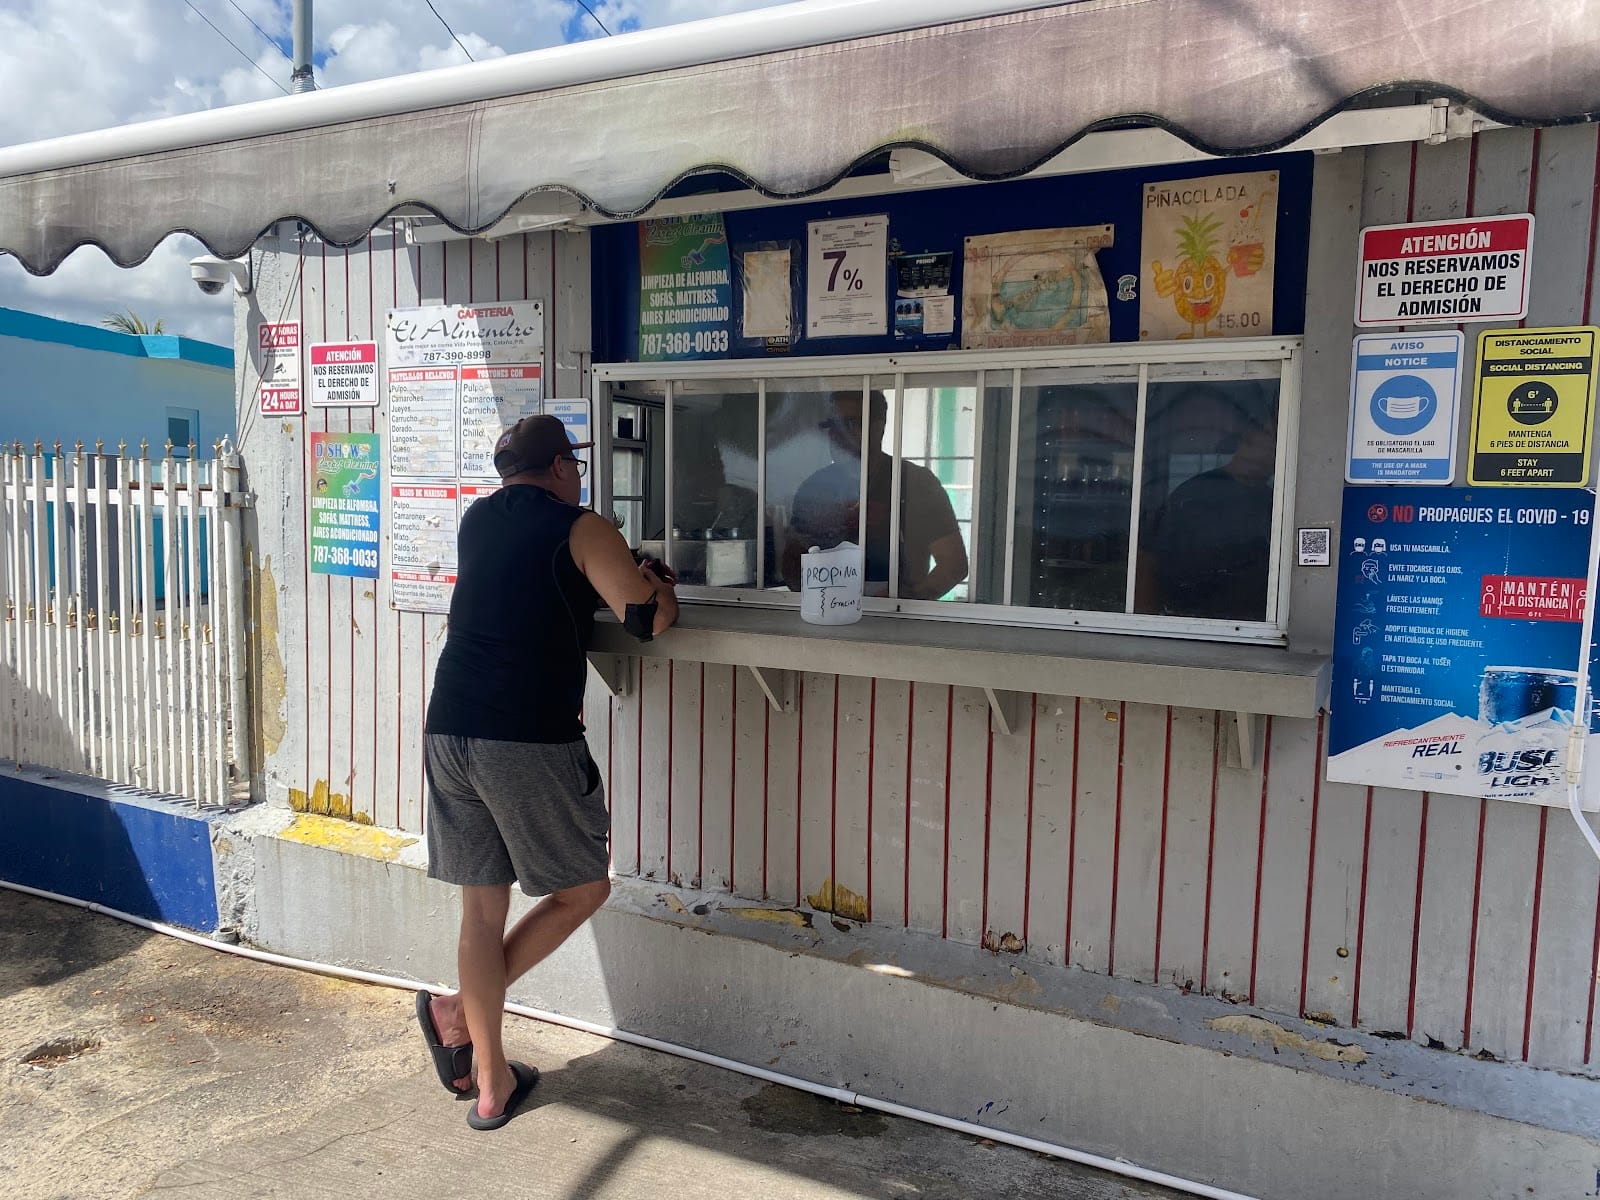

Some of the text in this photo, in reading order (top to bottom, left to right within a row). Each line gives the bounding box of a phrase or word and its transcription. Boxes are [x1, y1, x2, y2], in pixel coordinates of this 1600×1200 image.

[1401, 228, 1491, 254] ATENCIÓN
[1368, 253, 1520, 277] NOS RESERVAMOS
[641, 270, 729, 290] LIMPIEZA DE ALFOMBRA,
[1377, 275, 1507, 297] EL DERECHO DE
[1398, 294, 1481, 316] ADMISIÓN
[457, 306, 513, 320] CAFETERIA
[642, 307, 729, 325] AIRES ACONDICIONADO
[392, 320, 417, 342] El
[279, 336, 286, 345] AL
[642, 330, 729, 355] 787-368-0033
[1390, 341, 1424, 351] AVISO
[1495, 337, 1581, 347] DISTANCIAMIENTO
[326, 347, 362, 361] ATENCIÓN
[423, 350, 491, 362] 787-390-8998
[1384, 357, 1428, 367] NOTICE
[1489, 362, 1583, 372] SOCIAL DISTANCING
[313, 364, 374, 375] NOS RESERVAMOS
[318, 378, 369, 388] EL DERECHO DE
[327, 388, 360, 400] ADMISIÓN
[463, 395, 504, 403] Camarones
[262, 391, 298, 410] 24 HOURS
[280, 401, 296, 409] A DAY
[463, 406, 496, 414] Carrucho
[391, 425, 412, 433] Dorado
[392, 436, 418, 444] Langosta
[463, 451, 484, 460] Carne
[463, 463, 483, 471] Alitas
[1517, 459, 1538, 467] STAY
[1527, 468, 1554, 477] APART
[312, 497, 337, 510] LIMPIEZA
[337, 498, 345, 510] DE
[393, 501, 409, 509] Pulpo
[394, 512, 426, 520] Camarones
[1393, 505, 1414, 523] NO
[1419, 507, 1493, 523] PROPAGUES
[1498, 508, 1513, 524] EL
[1517, 508, 1557, 525] COVID
[1572, 509, 1589, 525] 19
[394, 522, 420, 530] Carrucho
[313, 526, 378, 542] AIRES ACONDICIONADO
[394, 544, 411, 552] Caldo
[1390, 544, 1401, 552] USA
[1403, 544, 1411, 552] TU
[313, 545, 378, 568] 787-368-0033
[394, 554, 419, 563] Pescado
[1388, 564, 1406, 572] EVITE
[1407, 565, 1432, 573] TOCARSE
[1446, 566, 1463, 575] OJOS,
[1397, 575, 1415, 583] NARIZ
[1505, 580, 1570, 597] MANTÉN
[1386, 594, 1408, 603] LÁVESE
[1422, 597, 1443, 605] MANOS
[1503, 596, 1568, 610] LA DISTANCIA
[1385, 625, 1408, 633] ADOPTE
[1409, 626, 1435, 634] MEDIDAS
[1446, 628, 1469, 637] HIGIENE
[1394, 635, 1425, 644] ARTÍCULOS
[1427, 637, 1434, 645] DE
[1397, 655, 1405, 663] TU
[1406, 656, 1422, 664] BOCA
[1432, 658, 1451, 667] TOSER
[1387, 665, 1425, 674] ESTORNUDAR
[1382, 685, 1413, 694] MANTENGA
[1381, 695, 1432, 706] DISTANCIAMIENTO
[1383, 734, 1466, 748] REFRESCANTEMENTE
[1412, 742, 1462, 758] REAL
